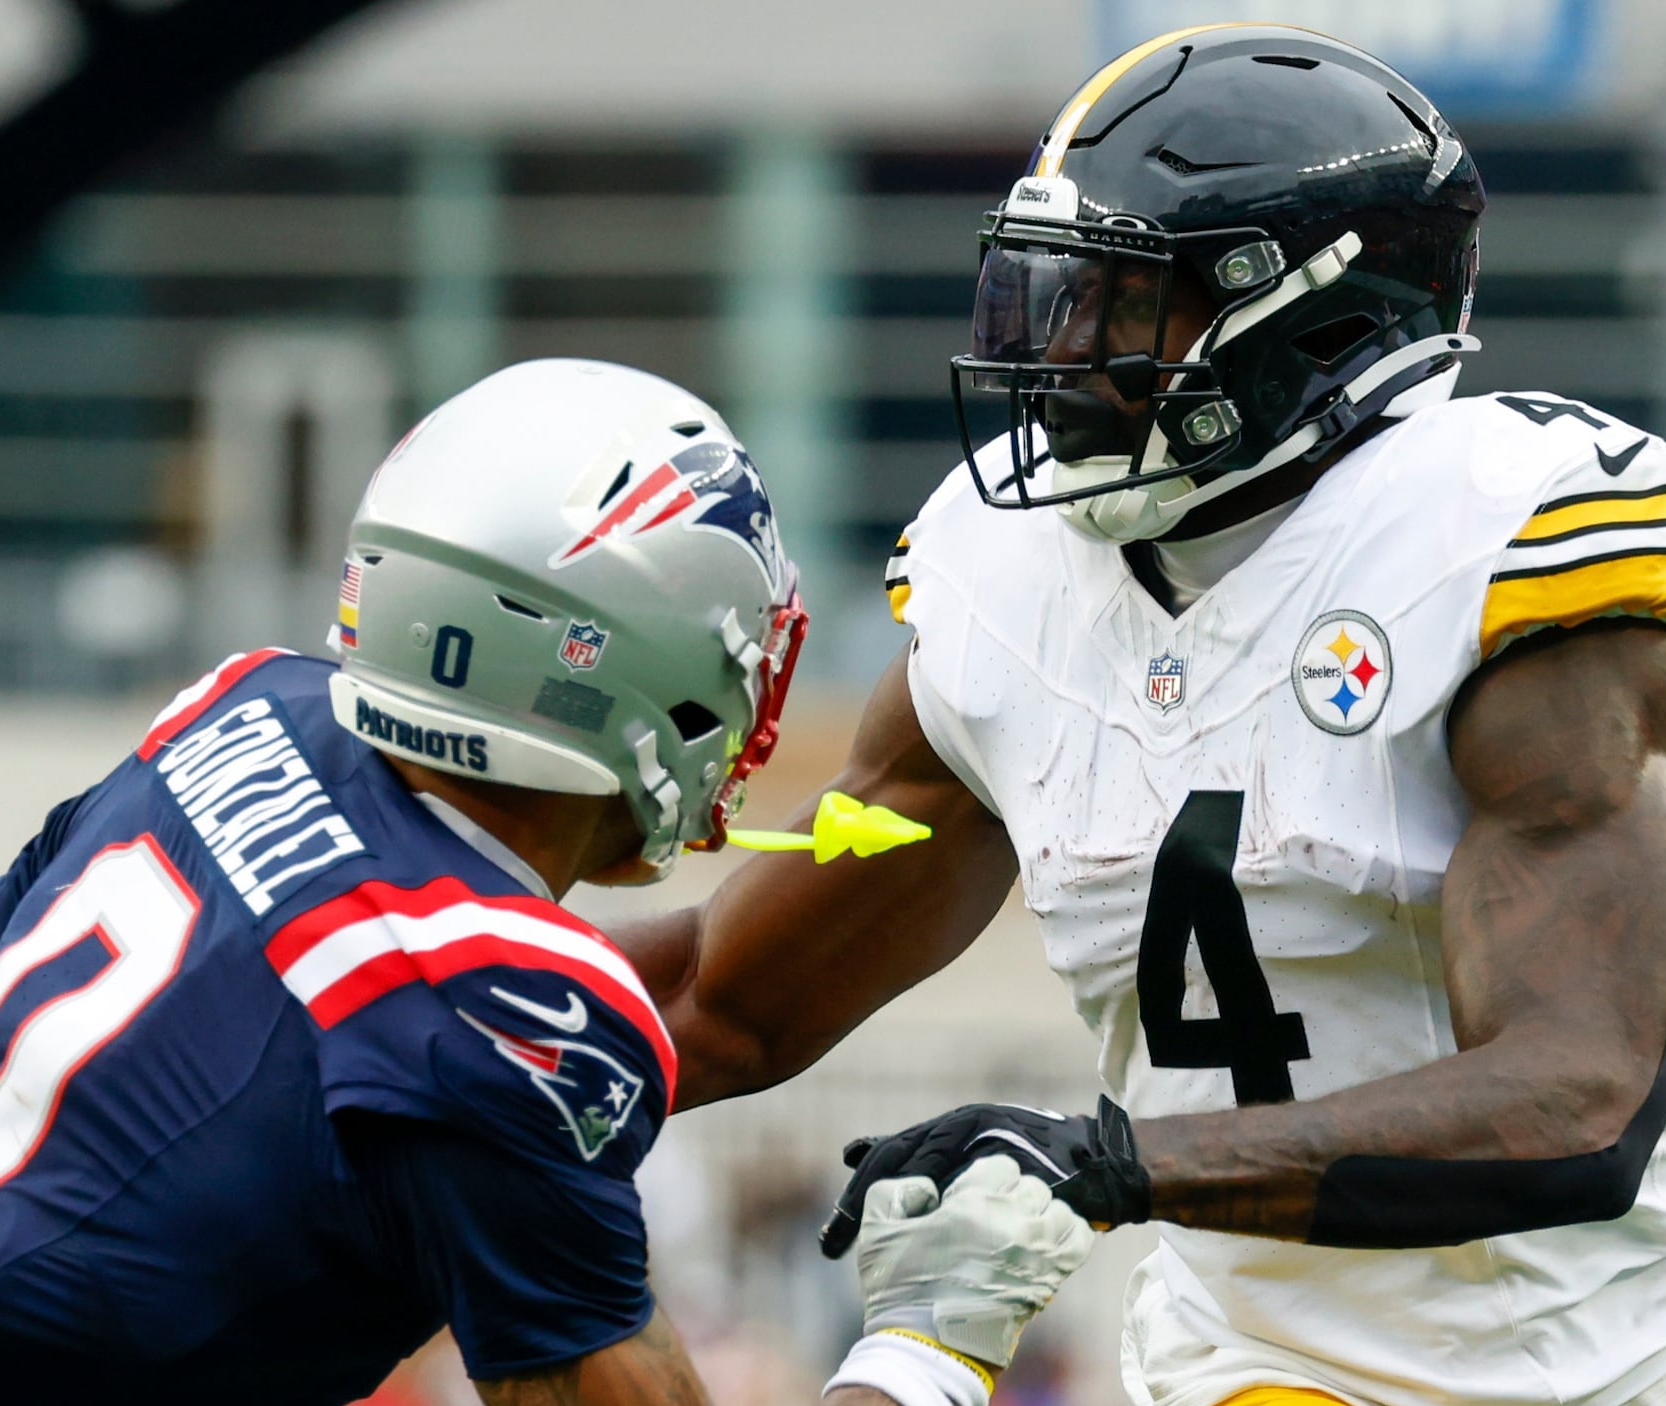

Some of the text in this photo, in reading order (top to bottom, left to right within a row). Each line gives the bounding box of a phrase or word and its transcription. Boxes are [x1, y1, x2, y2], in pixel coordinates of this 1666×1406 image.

[1495, 395, 1611, 431] 4
[430, 624, 474, 689] 0
[563, 639, 595, 666] NFL
[1302, 665, 1342, 680] Steelers
[1149, 676, 1180, 700] NFL
[355, 696, 489, 772] PATRIOTS
[156, 697, 366, 917] GONZALEZ
[1136, 789, 1312, 1108] 4
